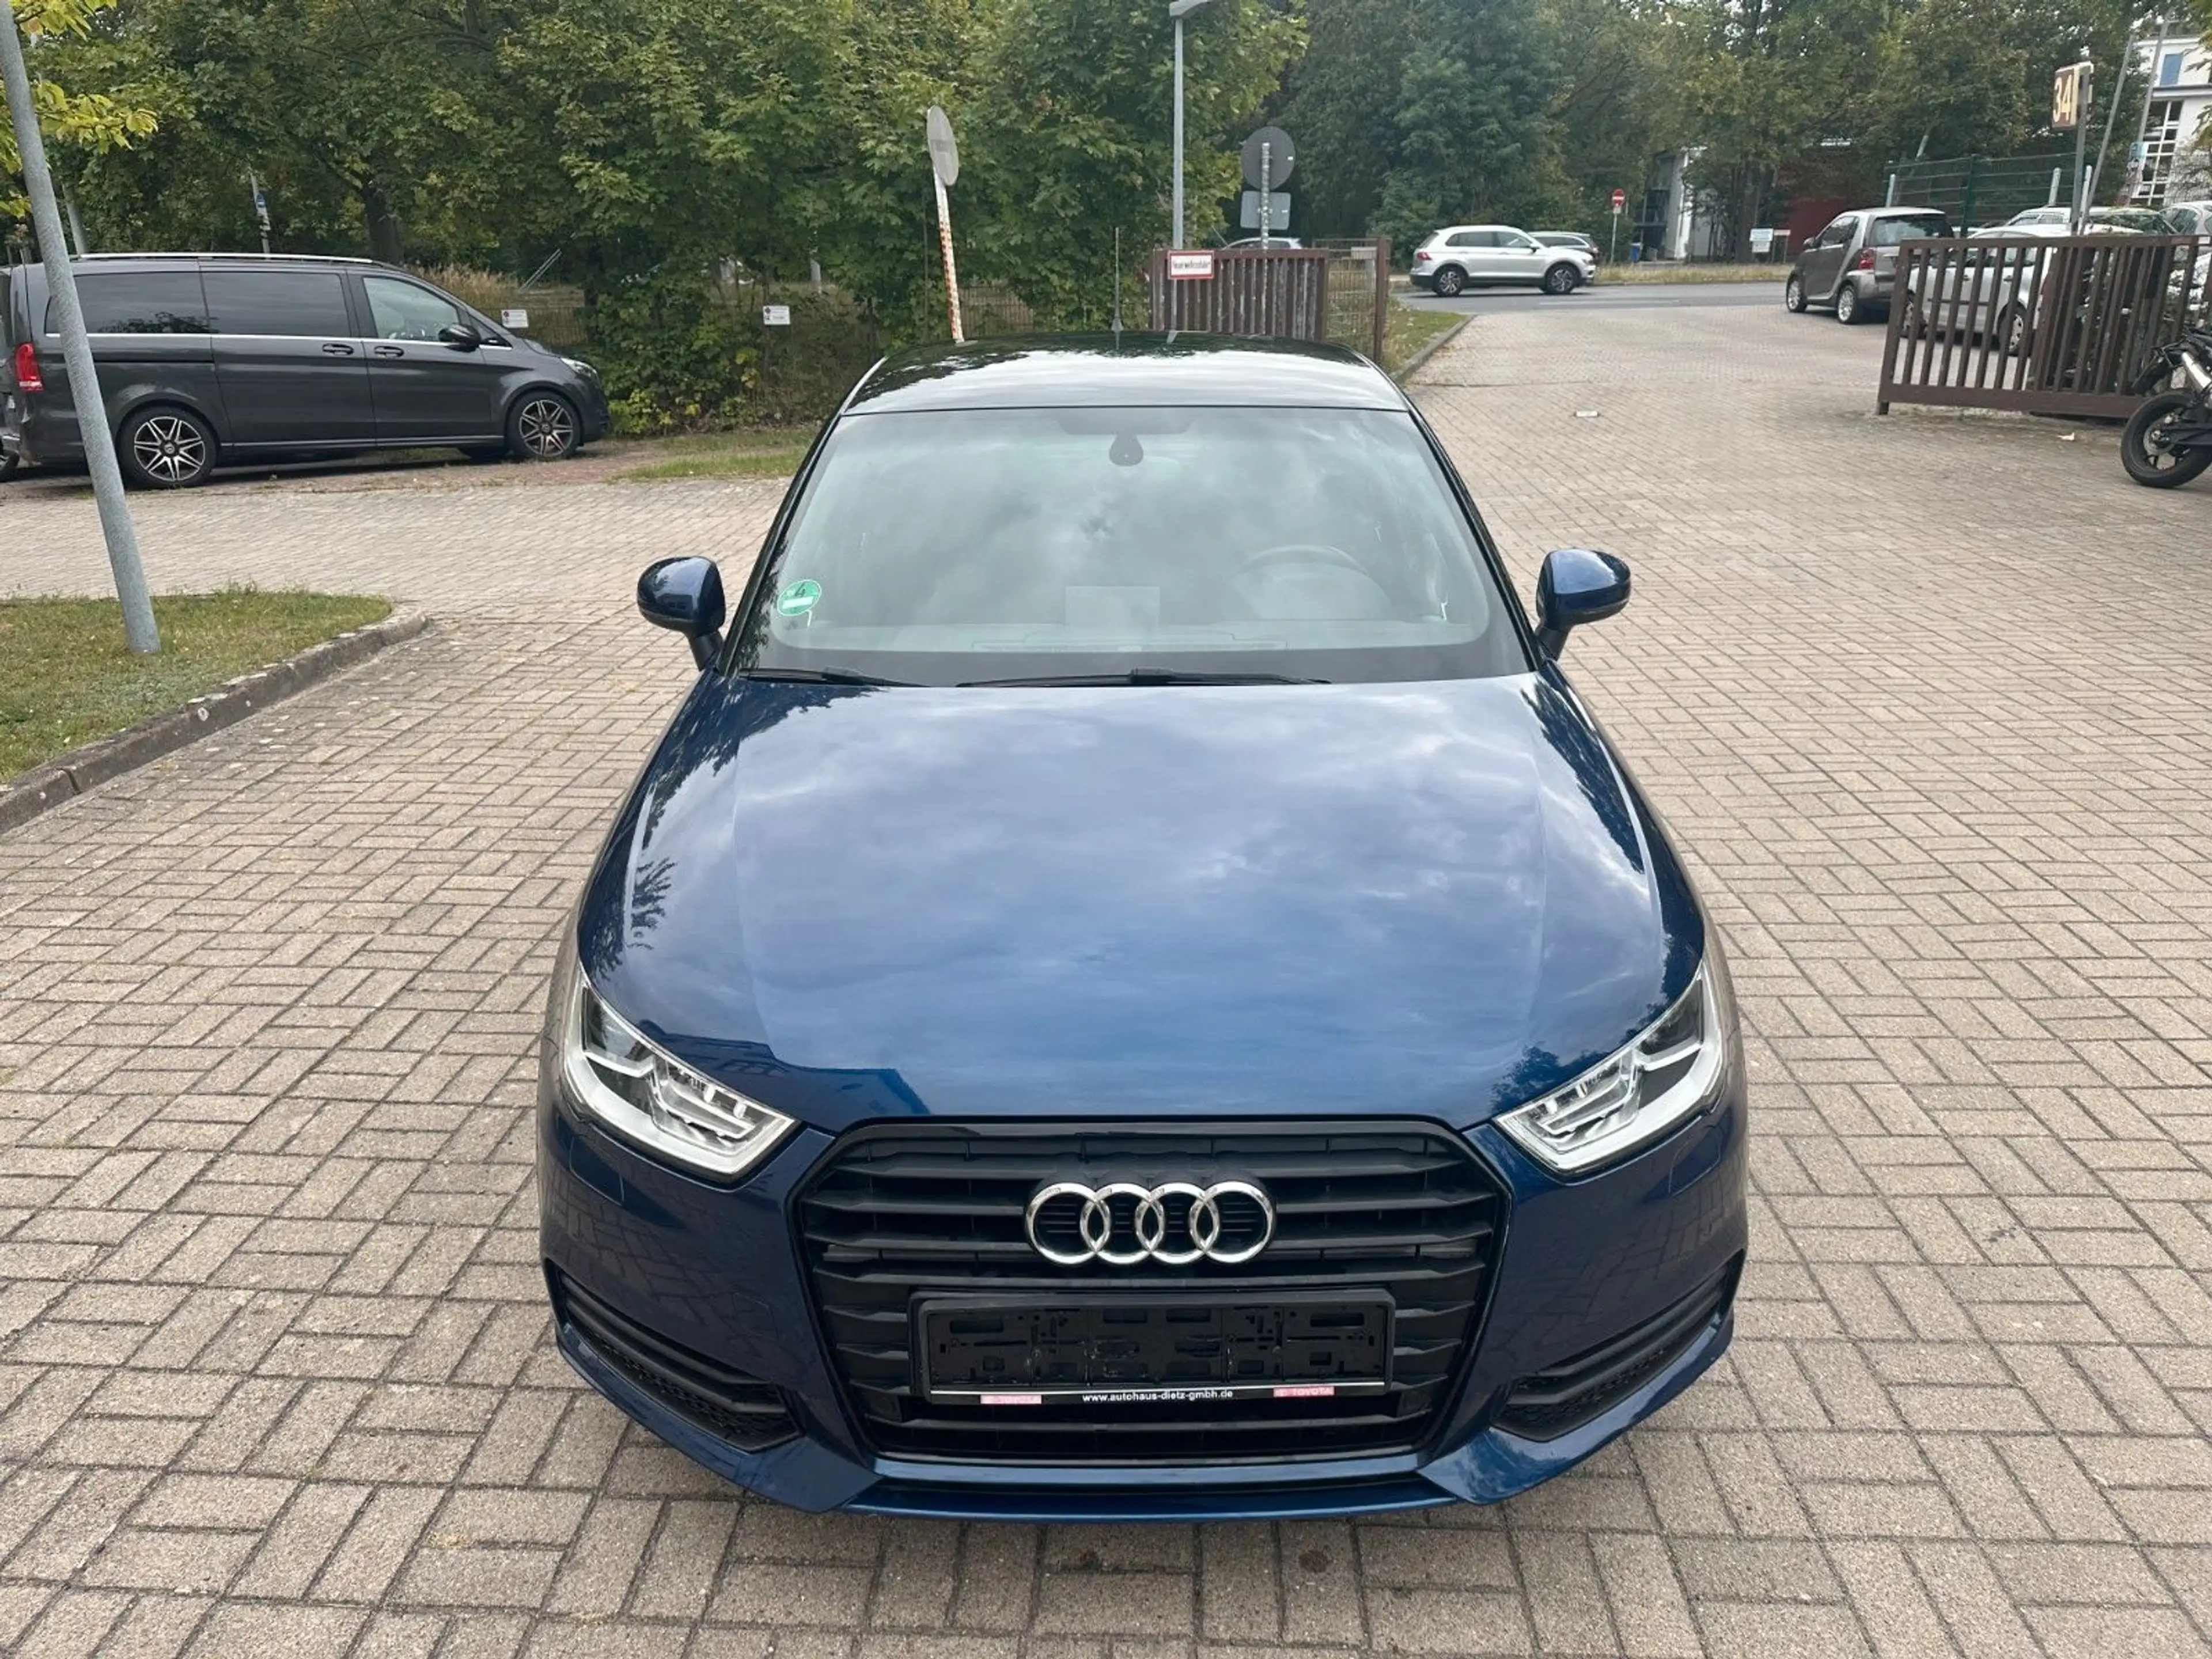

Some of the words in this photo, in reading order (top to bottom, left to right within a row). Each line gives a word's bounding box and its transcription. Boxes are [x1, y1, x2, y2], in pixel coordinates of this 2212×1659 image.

[2053, 74, 2072, 122] 34
[795, 581, 806, 597] 4
[1082, 1389, 1233, 1402] www.autohaus-dietz-gmbh.de
